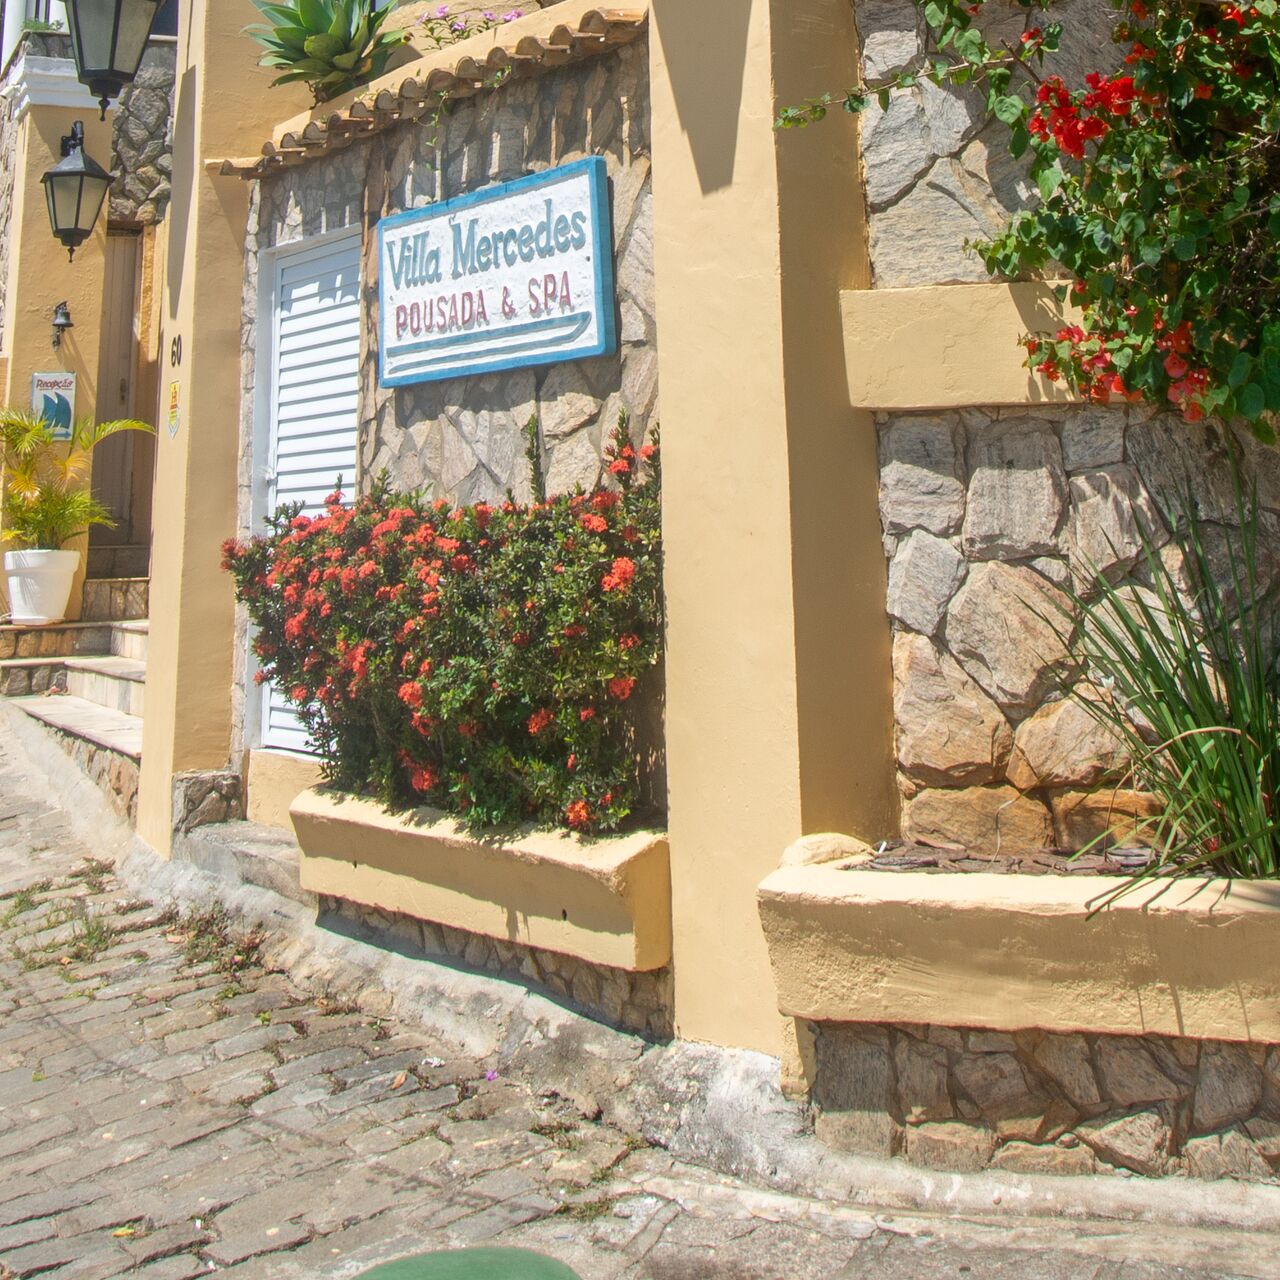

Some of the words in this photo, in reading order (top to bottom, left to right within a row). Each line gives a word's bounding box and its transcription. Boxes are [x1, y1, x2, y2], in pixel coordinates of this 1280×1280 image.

[385, 230, 444, 291] Villa
[449, 199, 587, 281] Mercedes
[395, 286, 489, 341] POUSADA
[501, 286, 516, 319] &
[528, 271, 574, 315] SPA
[171, 333, 182, 369] 60
